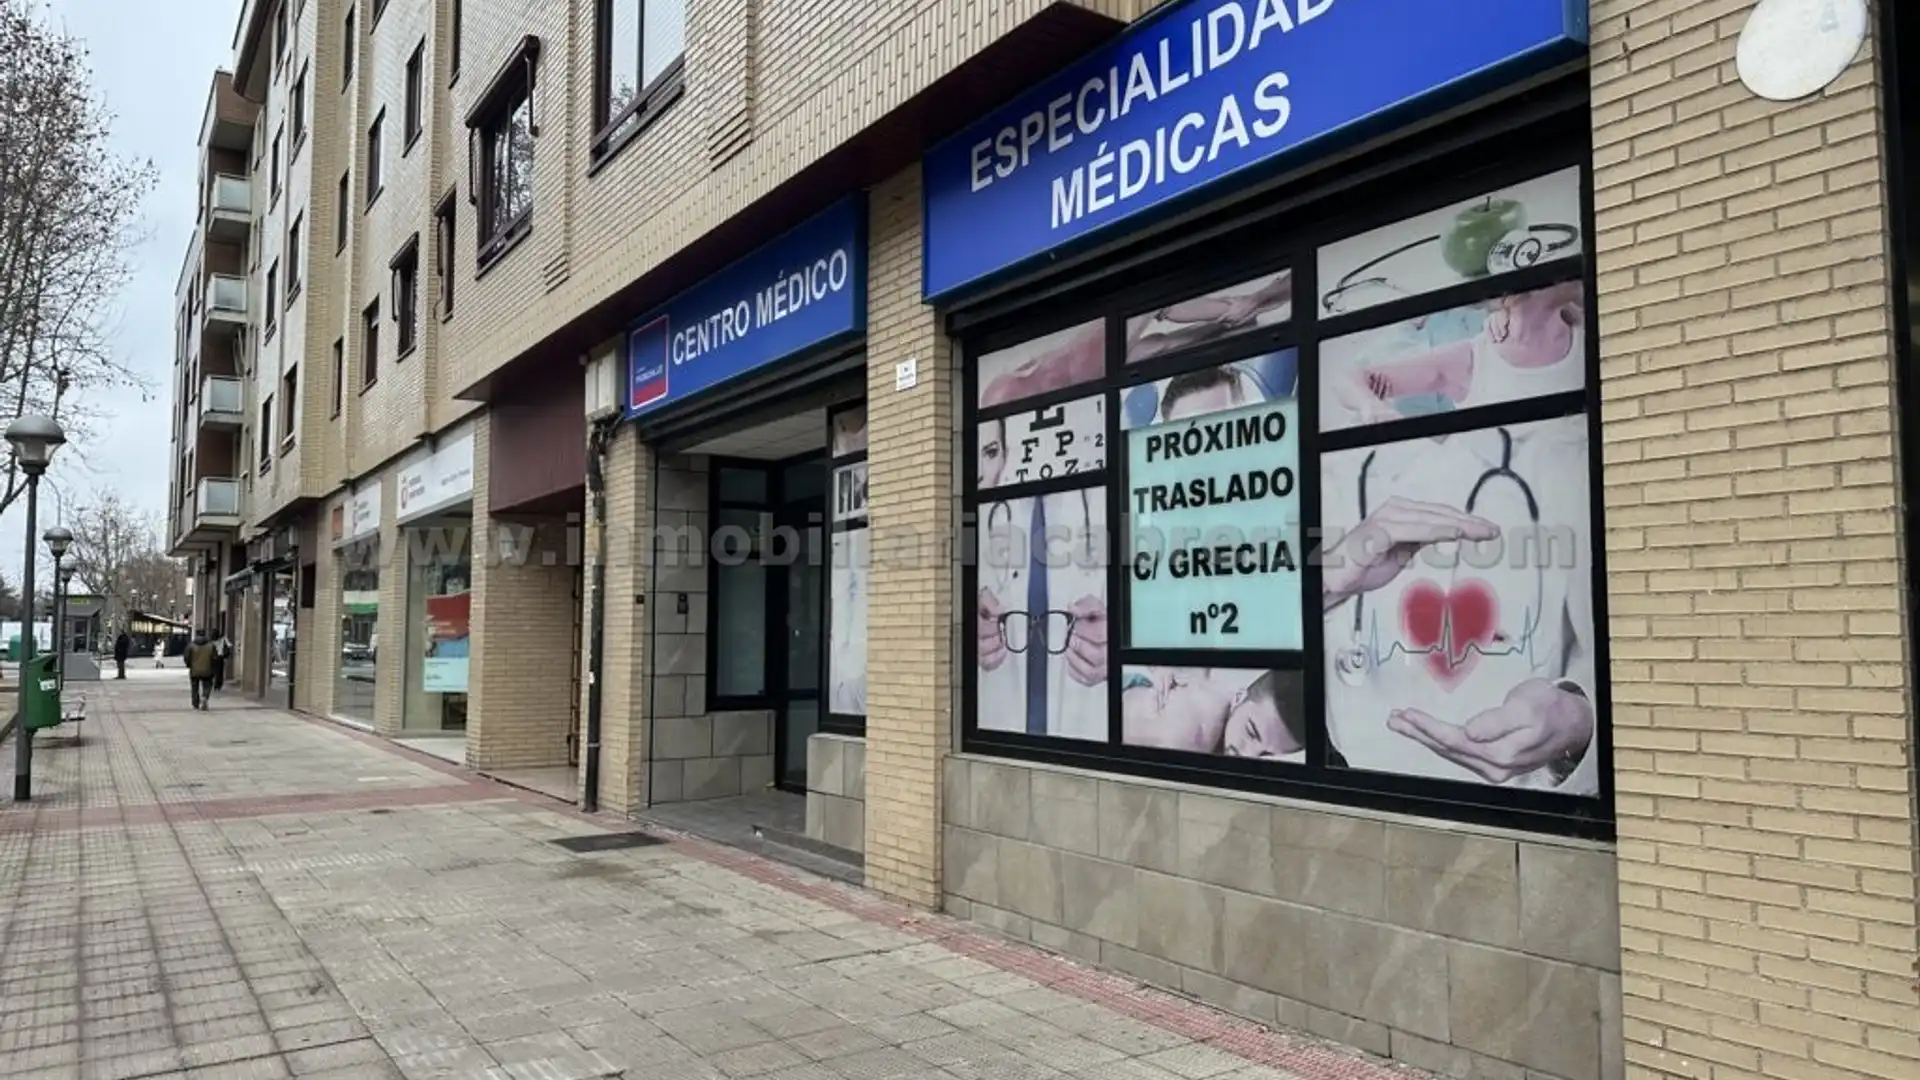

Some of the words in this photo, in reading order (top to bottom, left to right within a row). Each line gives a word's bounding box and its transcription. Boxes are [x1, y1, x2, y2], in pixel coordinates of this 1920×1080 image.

[1050, 71, 1291, 229] MÉDICAS
[672, 300, 749, 366] CENTRO
[755, 248, 848, 329] MÉDICO
[1146, 411, 1287, 463] PRÓXIMO
[1133, 466, 1295, 515] TRASLADO
[1133, 550, 1159, 582] C/
[1169, 540, 1297, 580] GRECIA
[1190, 602, 1240, 635] nº2
